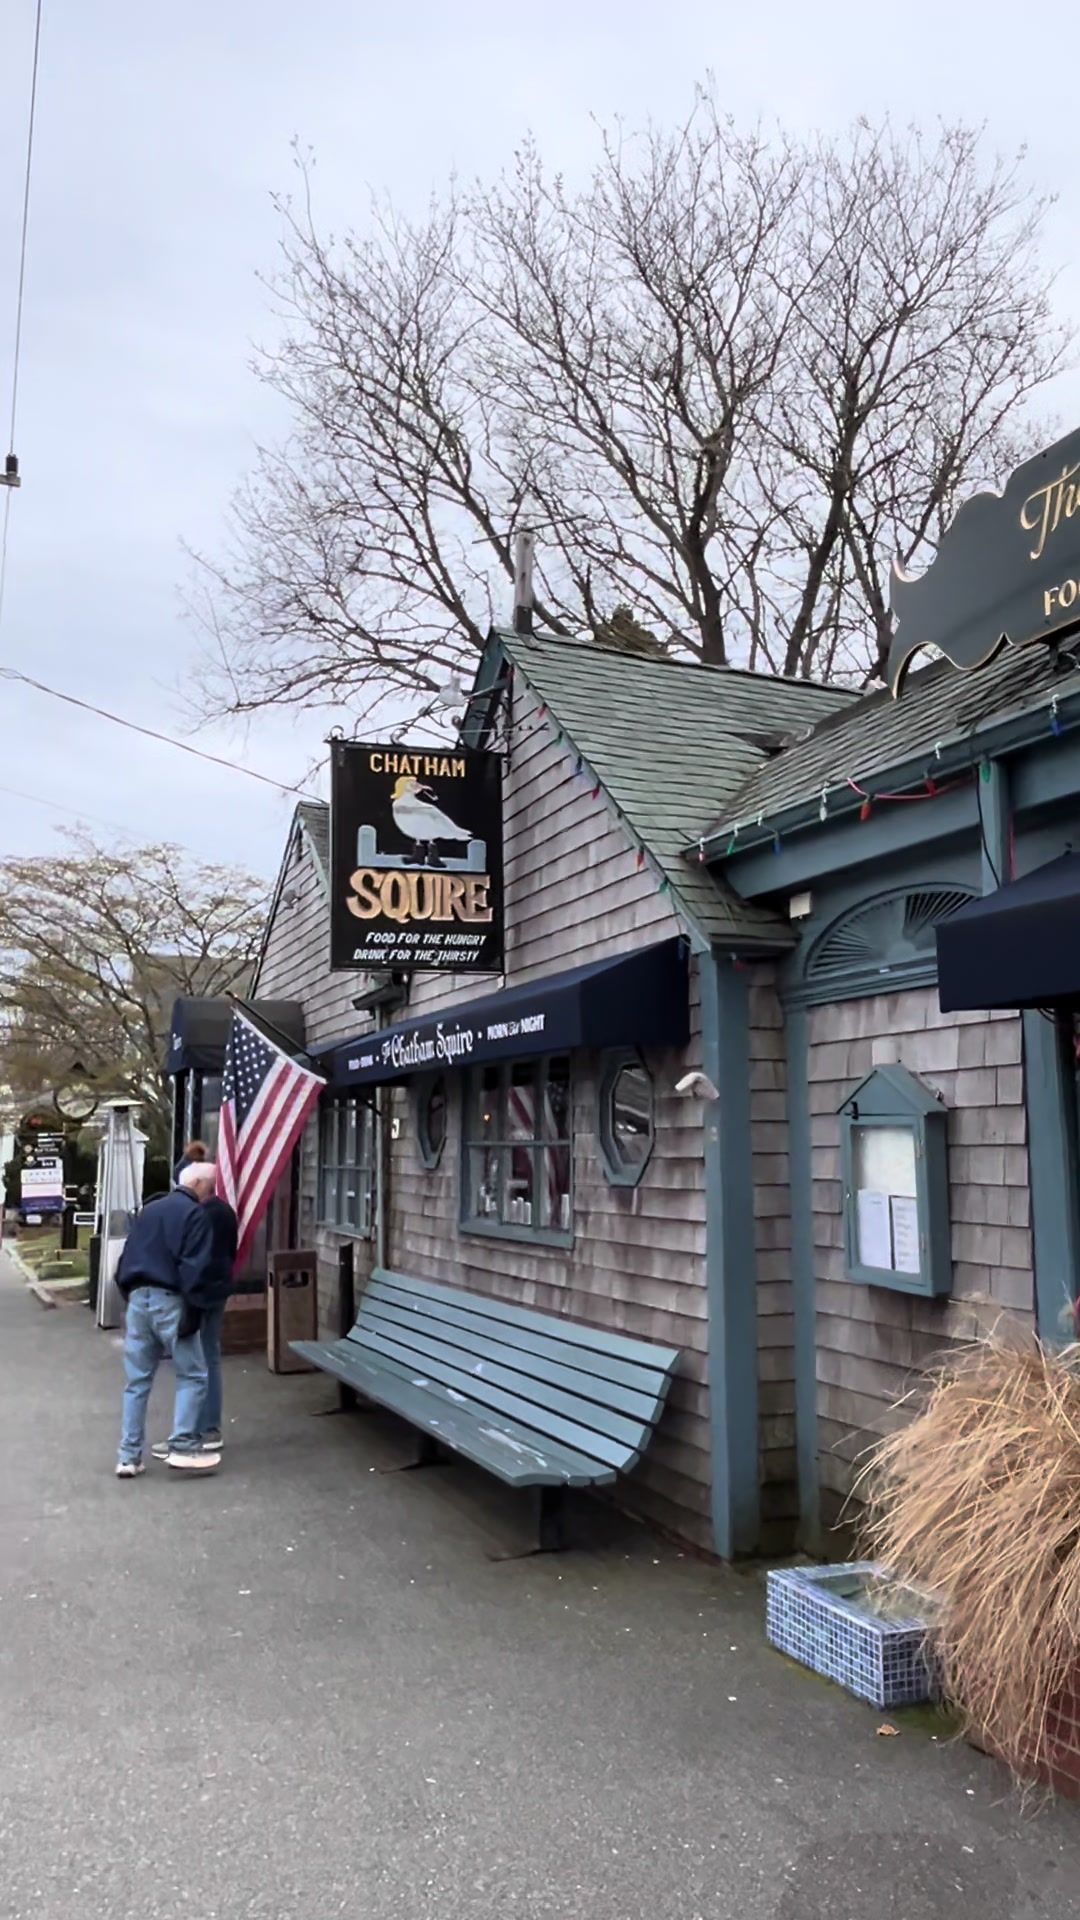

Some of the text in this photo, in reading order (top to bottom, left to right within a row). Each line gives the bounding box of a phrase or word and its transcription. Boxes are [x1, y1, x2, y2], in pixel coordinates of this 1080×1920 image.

[1020, 462, 1080, 560] Th
[1044, 579, 1080, 616] FO
[369, 752, 466, 778] CHATHAM
[346, 868, 494, 924] SQUIRE
[353, 948, 480, 962] DRINK FOR THE THIRSTY
[365, 931, 487, 946] FOOD FOR THE HUNGRY
[391, 1031, 435, 1069] Chatham
[435, 1021, 474, 1065] Squire
[520, 1013, 546, 1034] NIGHT
